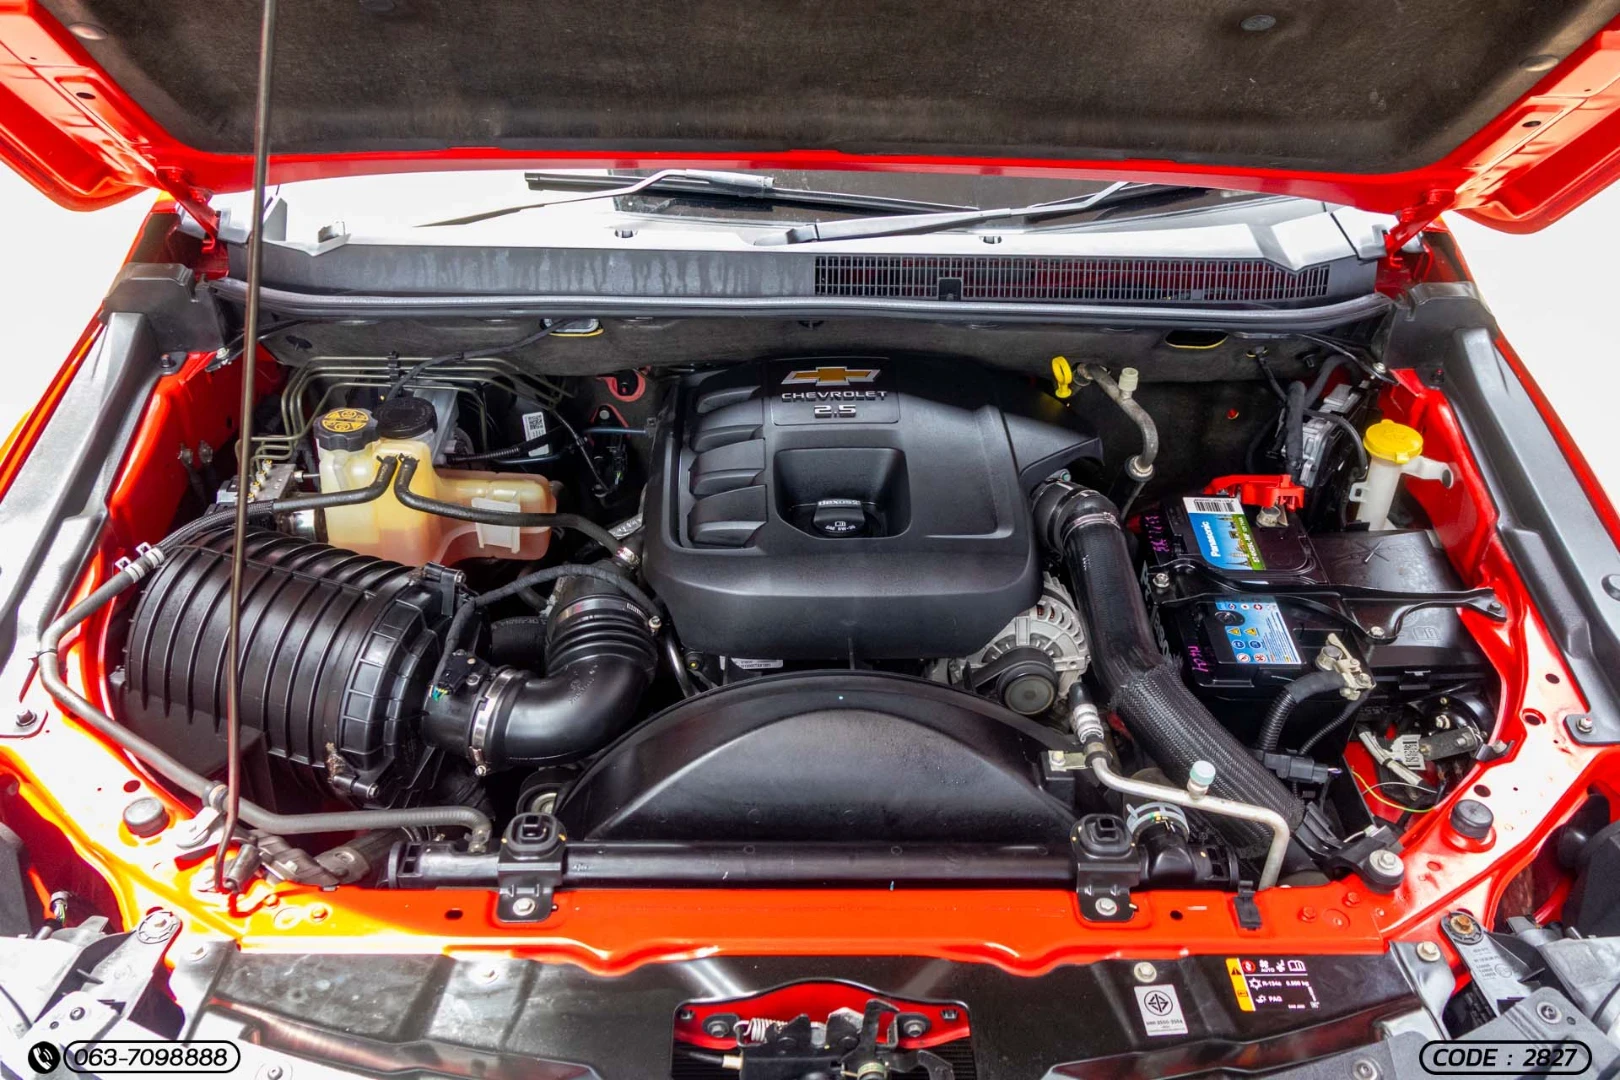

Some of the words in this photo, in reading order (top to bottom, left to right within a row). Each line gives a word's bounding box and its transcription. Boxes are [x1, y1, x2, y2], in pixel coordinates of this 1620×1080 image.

[781, 391, 887, 401] CHEVROLET
[814, 404, 857, 417] 2.5
[1201, 520, 1221, 557] Panasonic
